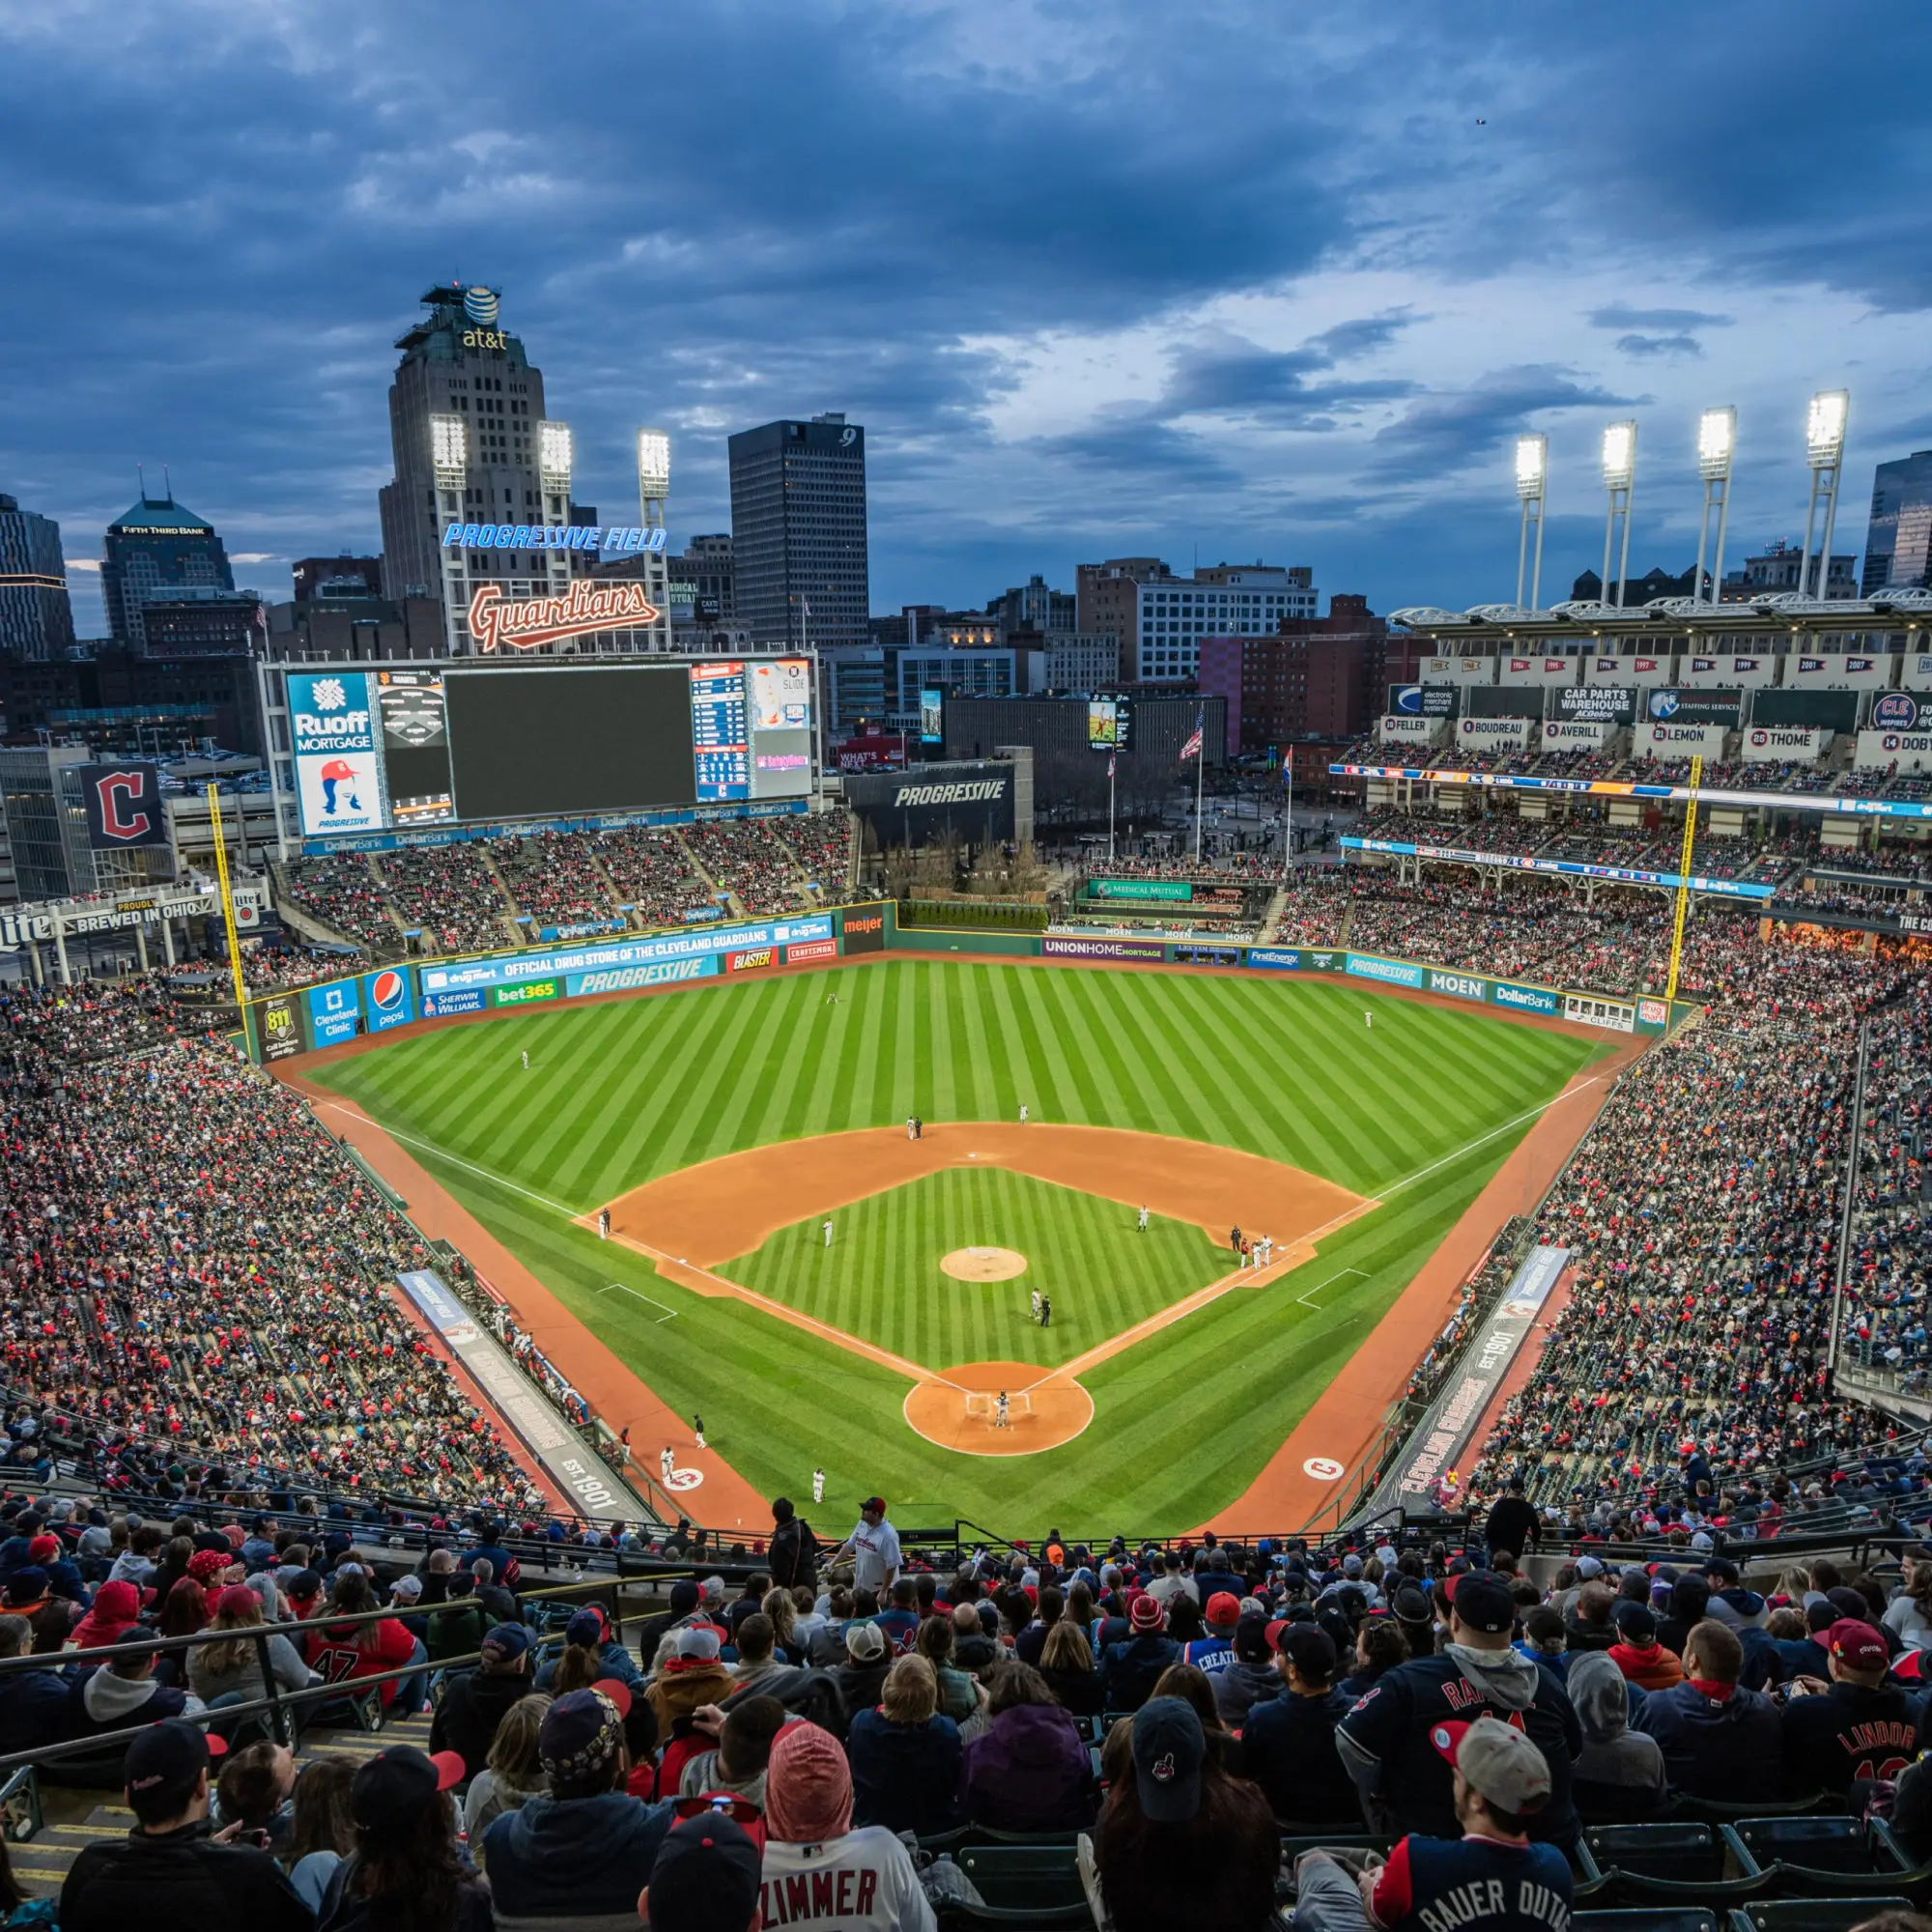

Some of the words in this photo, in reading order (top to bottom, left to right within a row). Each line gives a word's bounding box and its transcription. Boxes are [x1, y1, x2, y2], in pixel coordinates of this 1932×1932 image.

[463, 327, 507, 350] at&t
[442, 524, 602, 550] PROGRESSIVE
[604, 527, 667, 552] FIELD
[668, 582, 698, 592] EDICAL
[469, 580, 661, 653] Guardians
[1848, 661, 1864, 669] 2007
[783, 679, 805, 690] SLIDE
[1565, 690, 1591, 699] CAR
[1594, 690, 1628, 700] PARTS
[1561, 699, 1630, 710] WAREHOUSE
[1882, 700, 1909, 716] CLE
[1920, 705, 1932, 715] FO
[295, 711, 368, 735] Ruoff
[1396, 720, 1426, 731] FELLER
[1475, 723, 1522, 734] BOUDREAU
[1560, 725, 1599, 737] AVERILL
[1668, 729, 1704, 741] LEMON
[298, 735, 371, 751] MORTGAGE
[1771, 732, 1811, 747] THOME
[1885, 738, 1896, 747] 14
[840, 752, 877, 762] WHAT'S
[895, 781, 1007, 807] PROGRESSIVE
[97, 772, 150, 839] C
[749, 804, 792, 815] DollarBank
[319, 817, 371, 829] PROGRESSIVE
[325, 838, 382, 852] DollarBank
[396, 832, 451, 845] DollarBank
[1113, 885, 1148, 895] MEDICAL
[1150, 886, 1183, 895] MUTUAL
[117, 898, 158, 912] PROUDLY
[234, 895, 255, 908] Lite
[77, 911, 141, 932] BREWED
[146, 907, 160, 923] IN
[162, 902, 197, 919] OHIO
[1899, 916, 1919, 929] THE
[844, 917, 882, 934] meijer
[1165, 930, 1191, 939] MOEN
[1226, 933, 1254, 942] MOEN
[505, 961, 554, 977] OFFICIAL
[555, 953, 584, 969] DRUG
[585, 950, 618, 964] STORE
[620, 948, 634, 959] OF
[636, 945, 655, 957] THE
[656, 938, 711, 955] CLEVELAND
[713, 930, 767, 949] GUARDIANS
[1122, 949, 1161, 957] MORTGAGE
[1252, 952, 1297, 964] FirstEnergy
[734, 952, 771, 970] BLASTER
[580, 958, 702, 993] PROGRESSIVE
[1350, 958, 1417, 982] PROGRESSIVE
[449, 972, 472, 983] drug
[1432, 972, 1482, 996] MOEN
[438, 992, 479, 1005] SHERWIN
[497, 982, 554, 1003] bet365
[1497, 987, 1552, 1009] DollarBank
[268, 1009, 290, 1031] 811
[315, 1007, 358, 1027] Cleveland
[380, 1009, 405, 1027] pepsi
[1590, 1015, 1624, 1029] CLIFFS
[326, 1022, 352, 1037] Clinic
[1485, 1331, 1515, 1357] 1901
[562, 1459, 580, 1479] EST.
[573, 1474, 618, 1509] 1901
[312, 1648, 359, 1684] 47
[1837, 1721, 1917, 1755] LINDOR
[1418, 1879, 1506, 1932] BAUER
